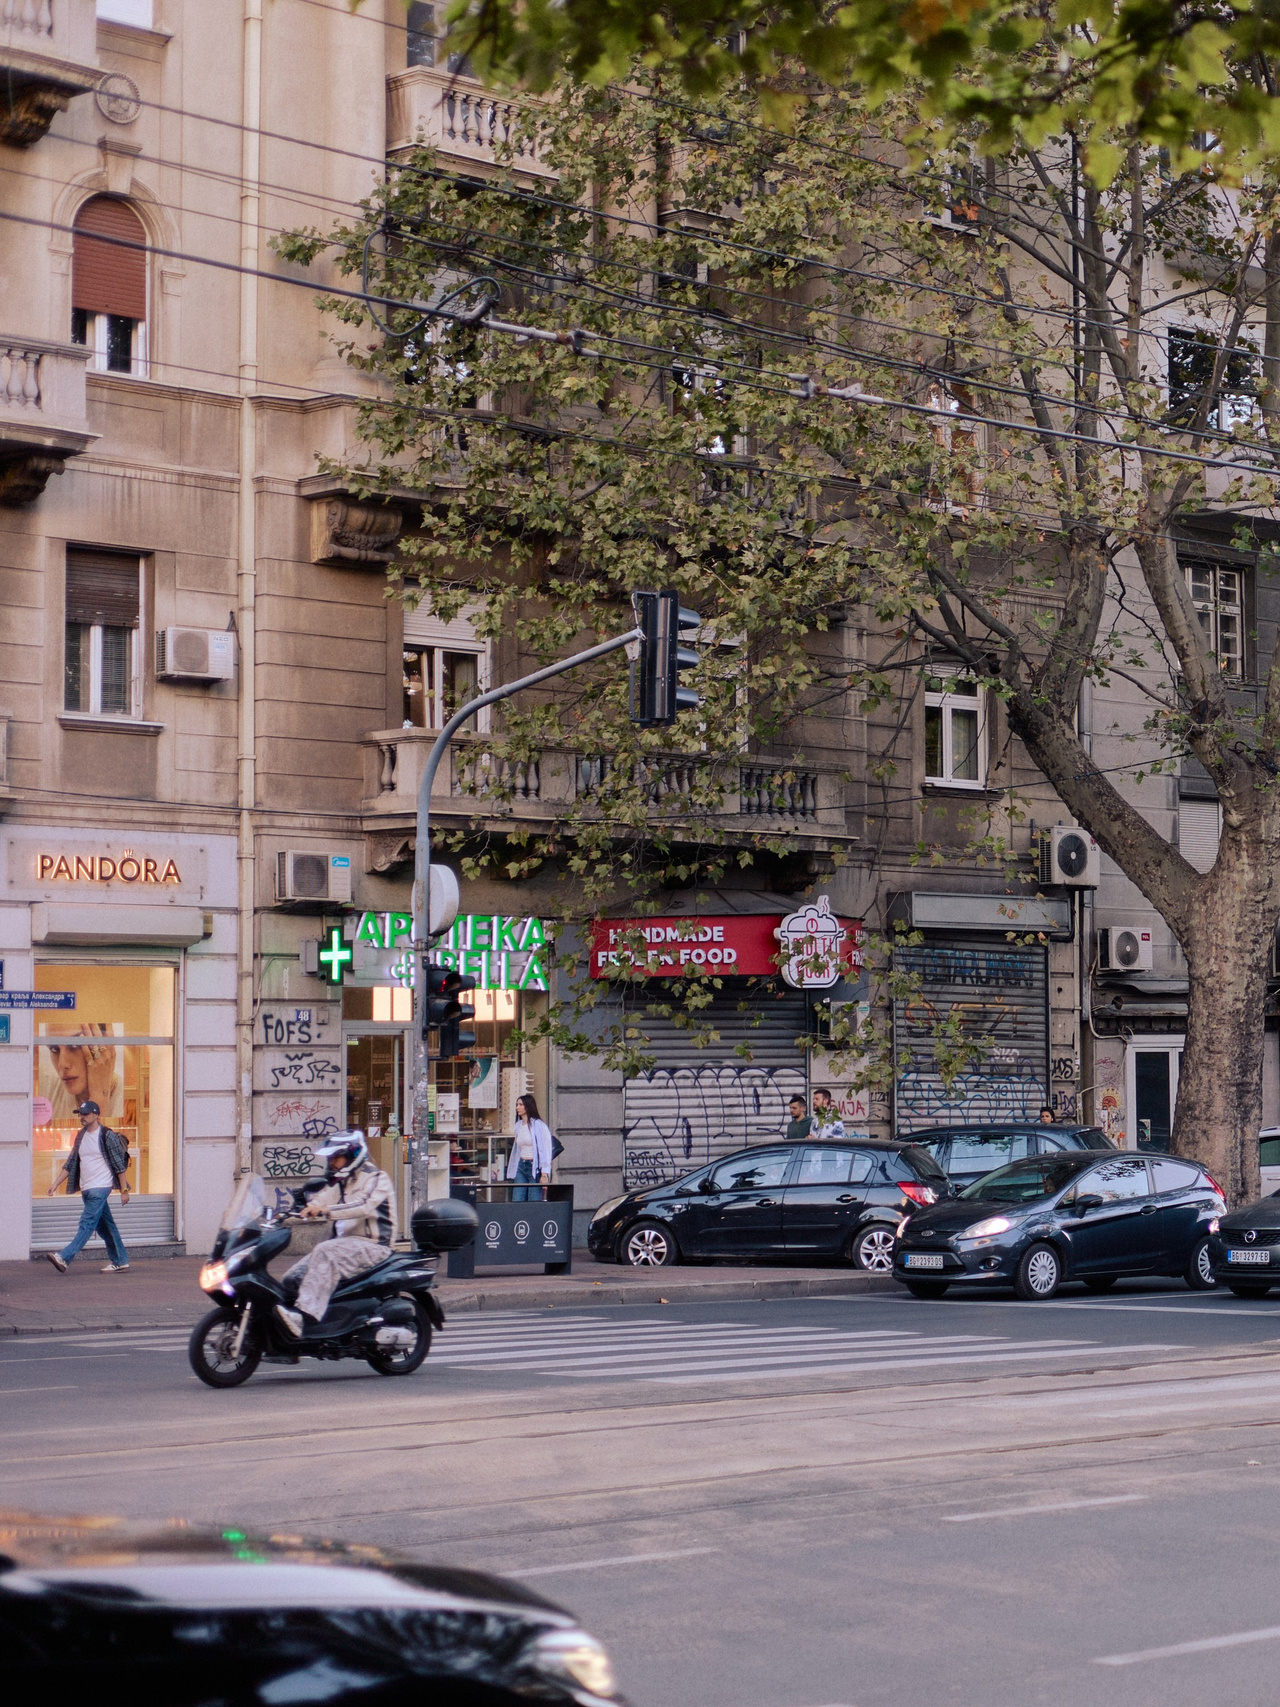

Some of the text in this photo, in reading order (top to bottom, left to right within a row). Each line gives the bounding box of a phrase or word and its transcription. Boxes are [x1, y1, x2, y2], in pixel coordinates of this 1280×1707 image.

[37, 853, 182, 884] PANDORA
[355, 911, 547, 951] APTEKA
[608, 926, 724, 945] HNDMADE
[680, 948, 737, 965] FOOD
[31, 992, 65, 1001] Александра
[298, 1010, 309, 1021] 48
[1231, 1251, 1239, 1260] BG
